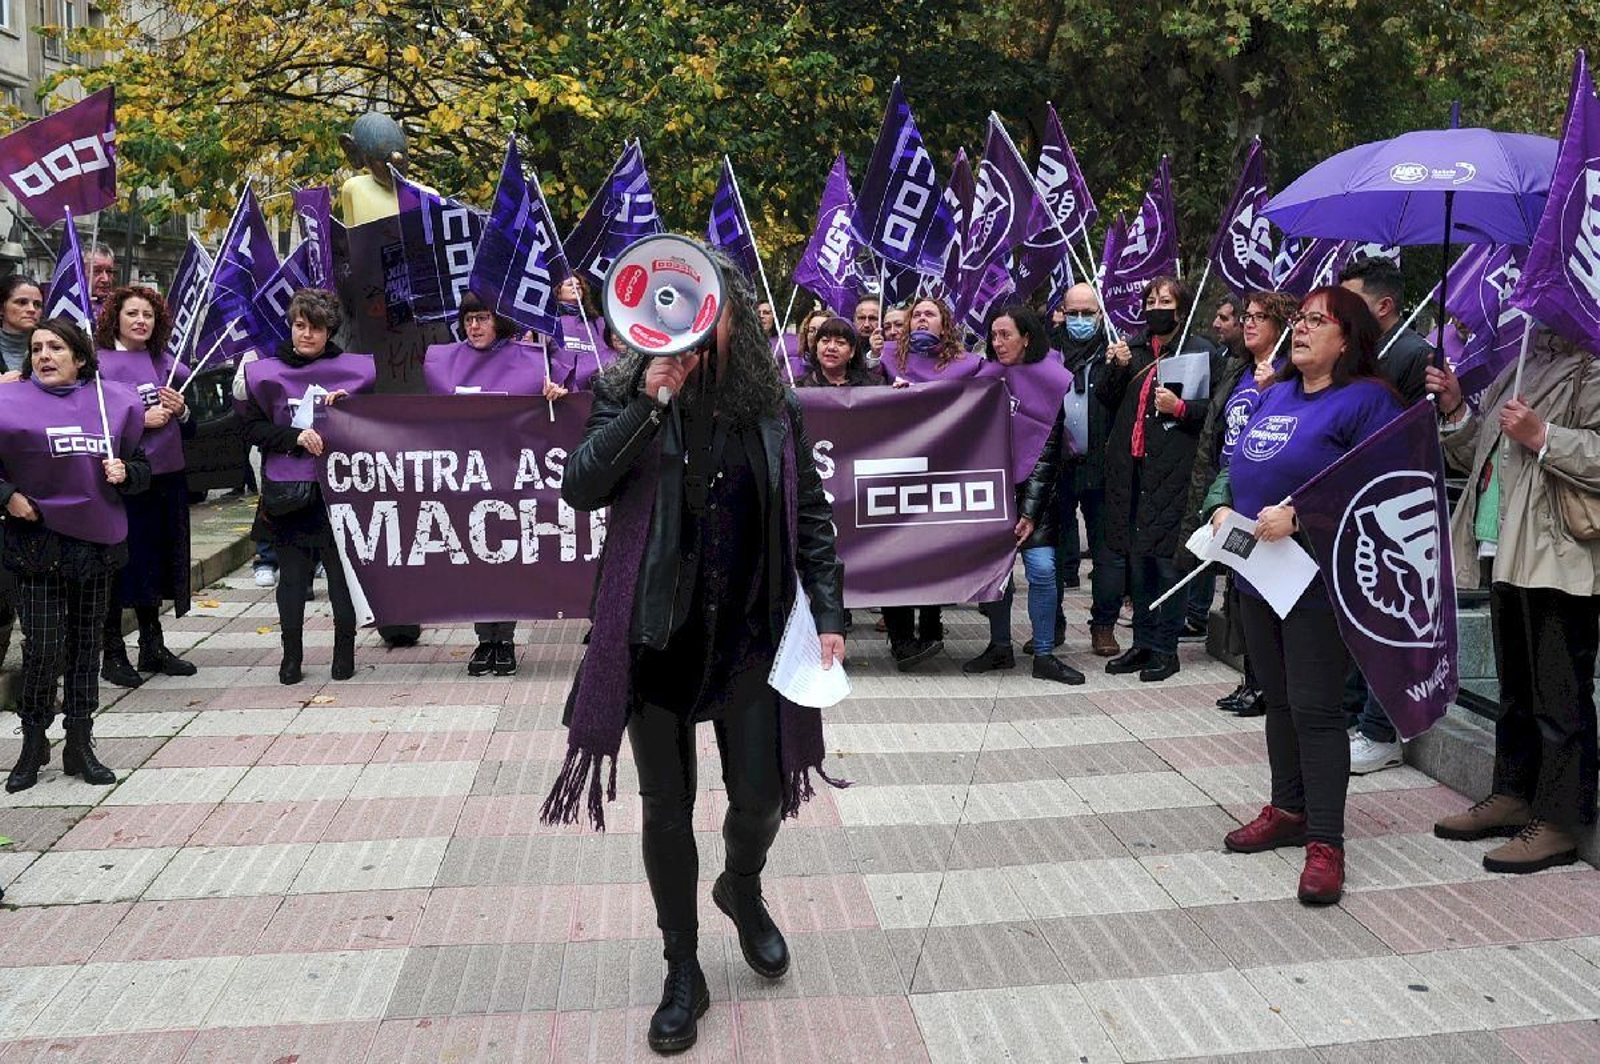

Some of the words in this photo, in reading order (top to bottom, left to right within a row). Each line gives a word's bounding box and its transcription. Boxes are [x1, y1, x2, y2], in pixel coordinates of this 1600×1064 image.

[327, 449, 492, 493] CONTRA
[513, 447, 567, 490] AS
[867, 480, 996, 517] CCOO
